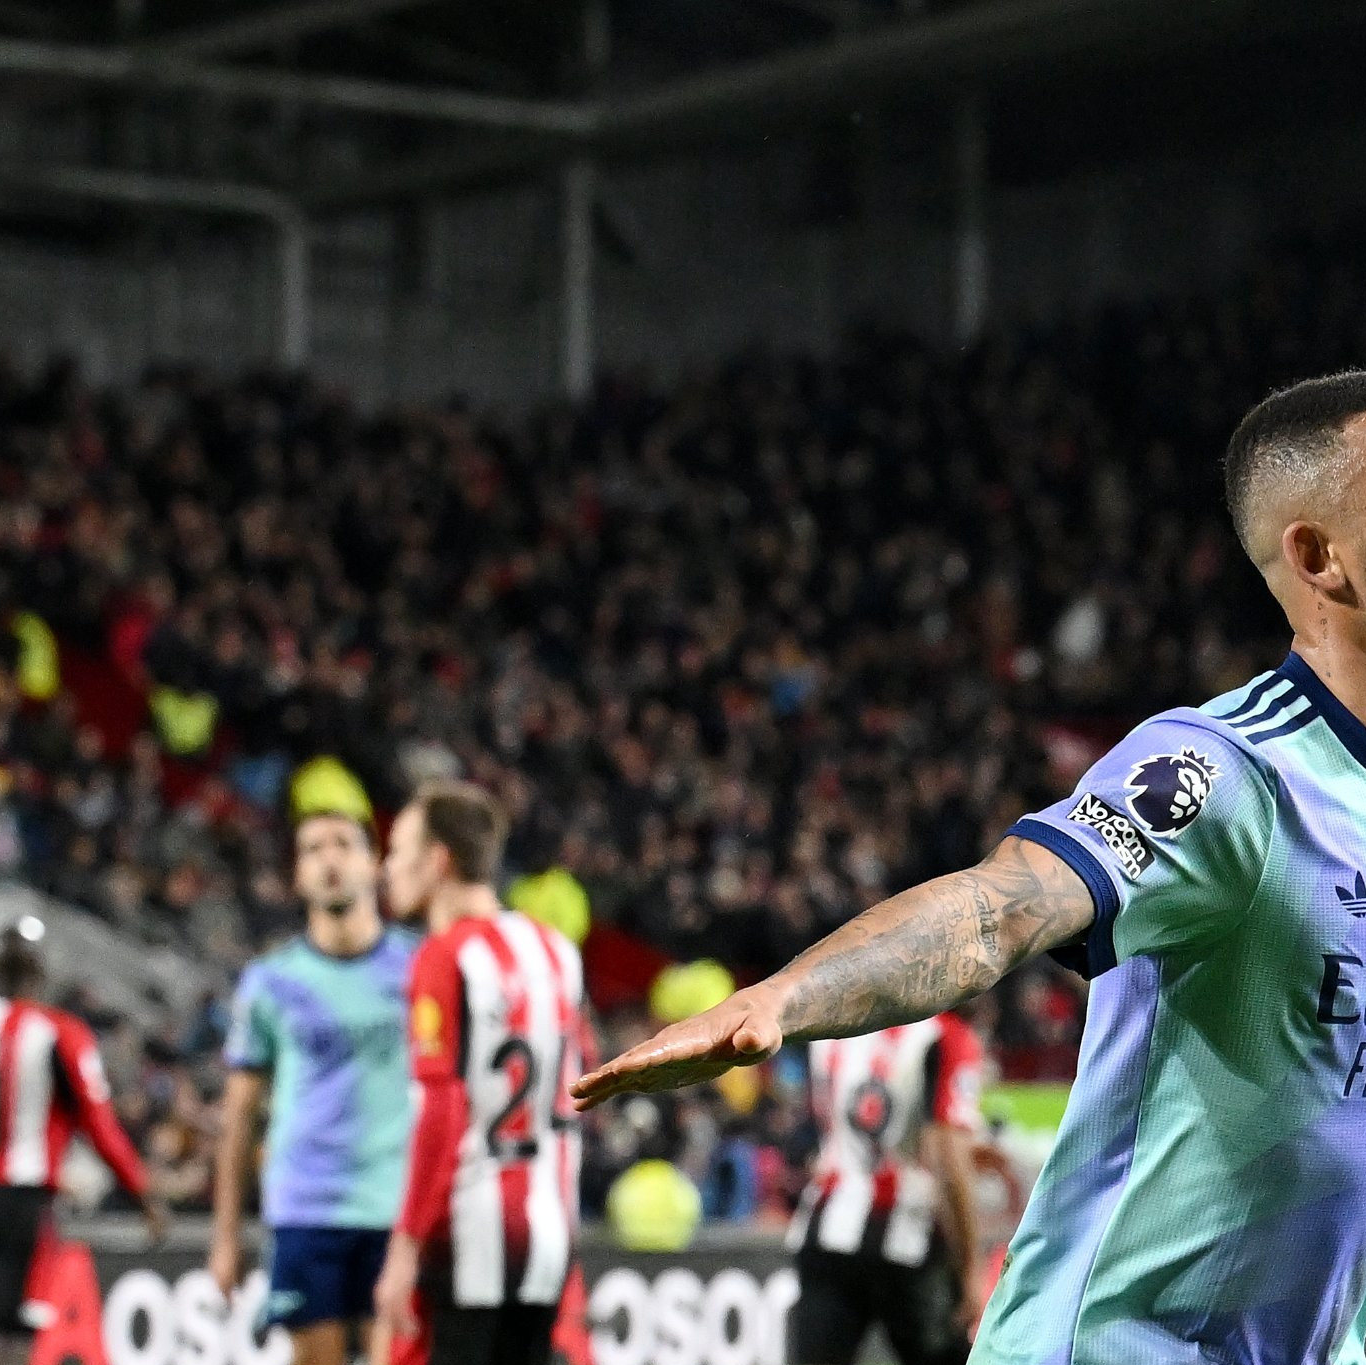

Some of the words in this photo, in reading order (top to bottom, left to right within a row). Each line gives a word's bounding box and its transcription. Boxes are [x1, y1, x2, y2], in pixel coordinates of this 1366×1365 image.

[1075, 792, 1109, 820] No
[1105, 814, 1147, 862] room
[1093, 820, 1142, 880] racism
